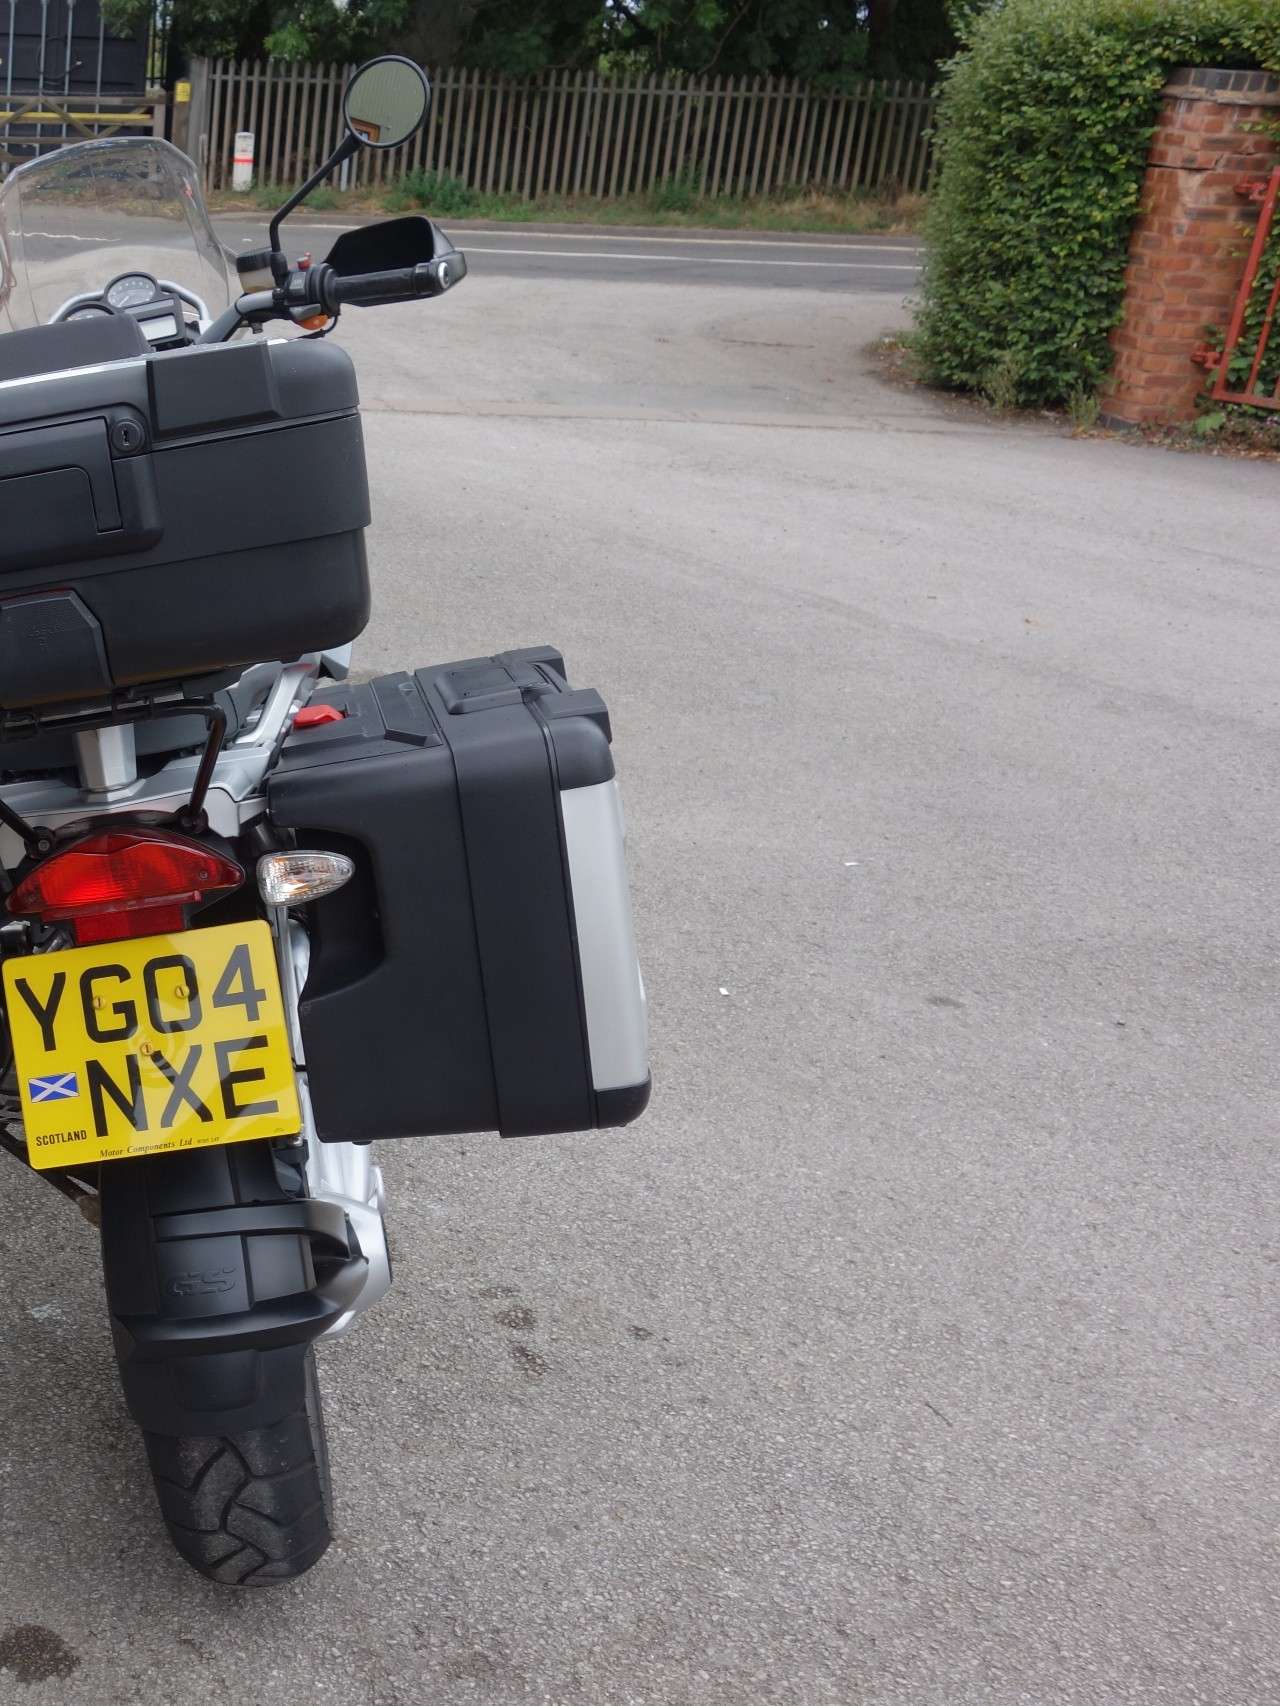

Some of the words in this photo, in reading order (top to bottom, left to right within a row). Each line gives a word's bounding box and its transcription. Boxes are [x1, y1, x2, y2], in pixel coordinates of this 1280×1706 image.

[14, 944, 267, 1052] YG04
[85, 1035, 280, 1137] NXE
[35, 1129, 87, 1147] SCOTLAND
[99, 1148, 123, 1158] Motor
[127, 1140, 175, 1154] Components
[179, 1137, 192, 1147] Ltd
